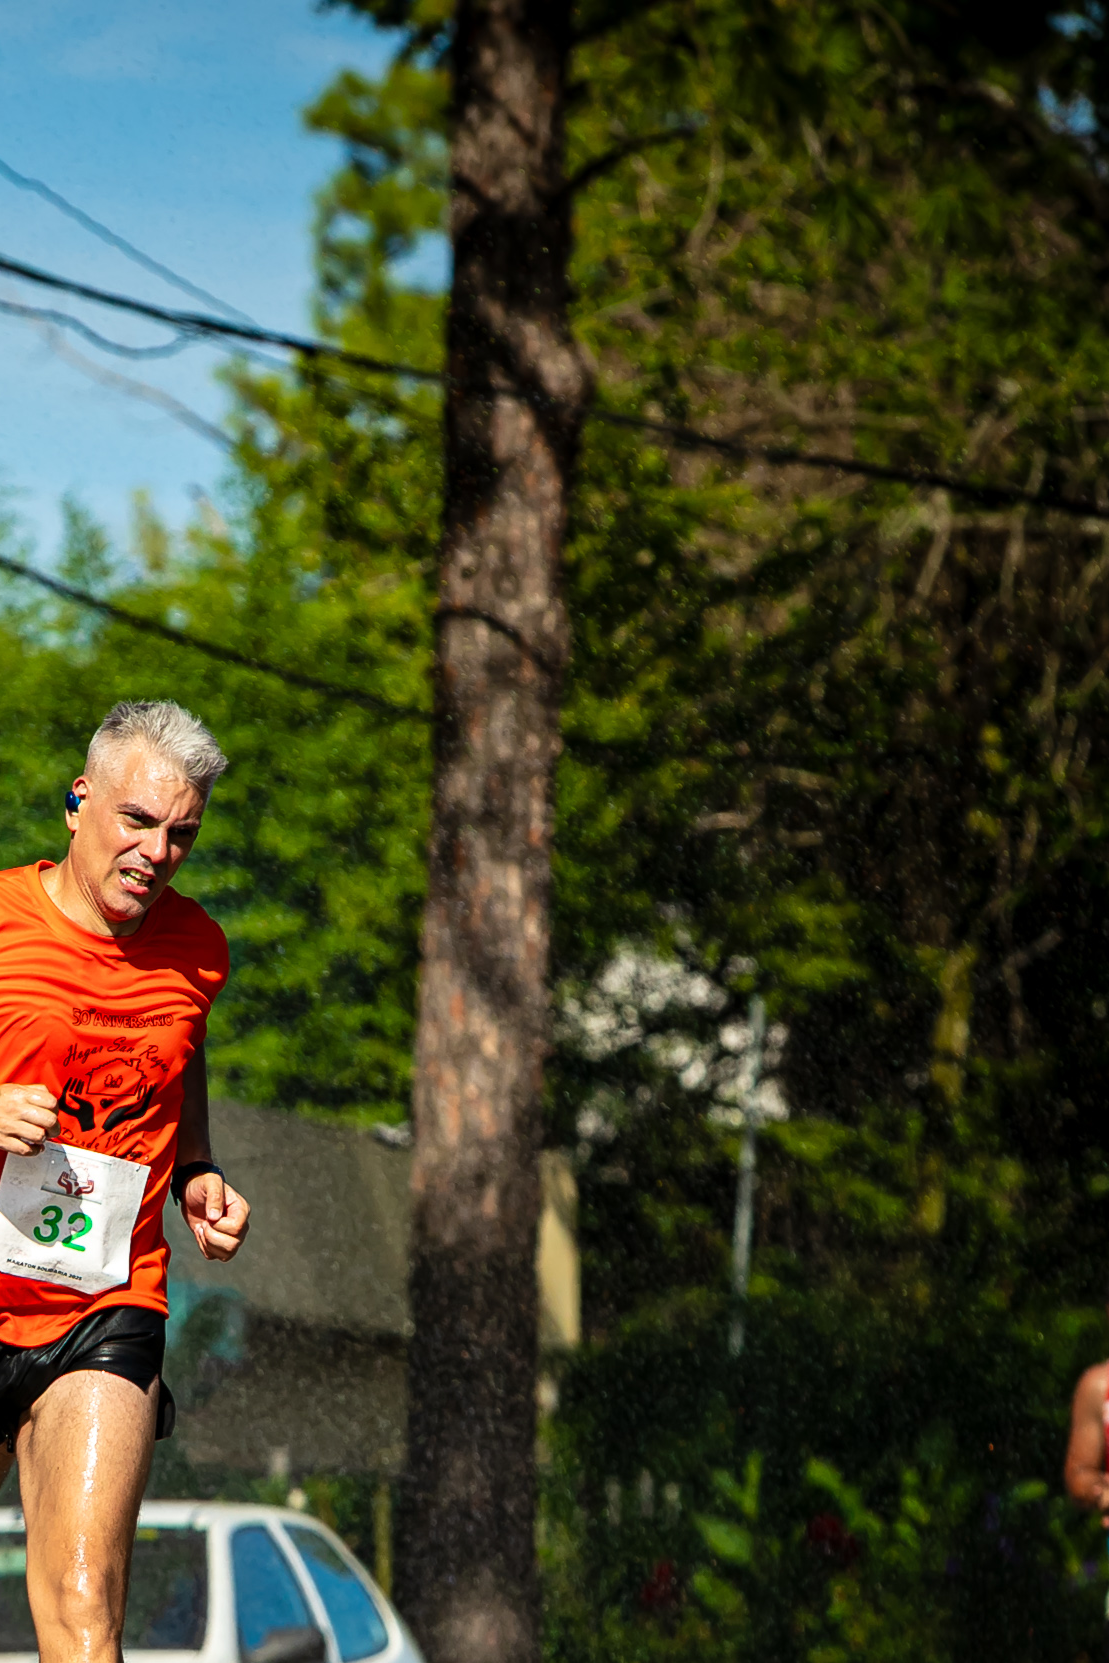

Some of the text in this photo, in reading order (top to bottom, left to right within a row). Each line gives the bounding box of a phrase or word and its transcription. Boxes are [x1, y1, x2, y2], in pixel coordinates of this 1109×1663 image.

[93, 1011, 174, 1028] ANIVERSARIO
[63, 1037, 170, 1073] Hogar San Roque
[33, 1205, 93, 1252] 32
